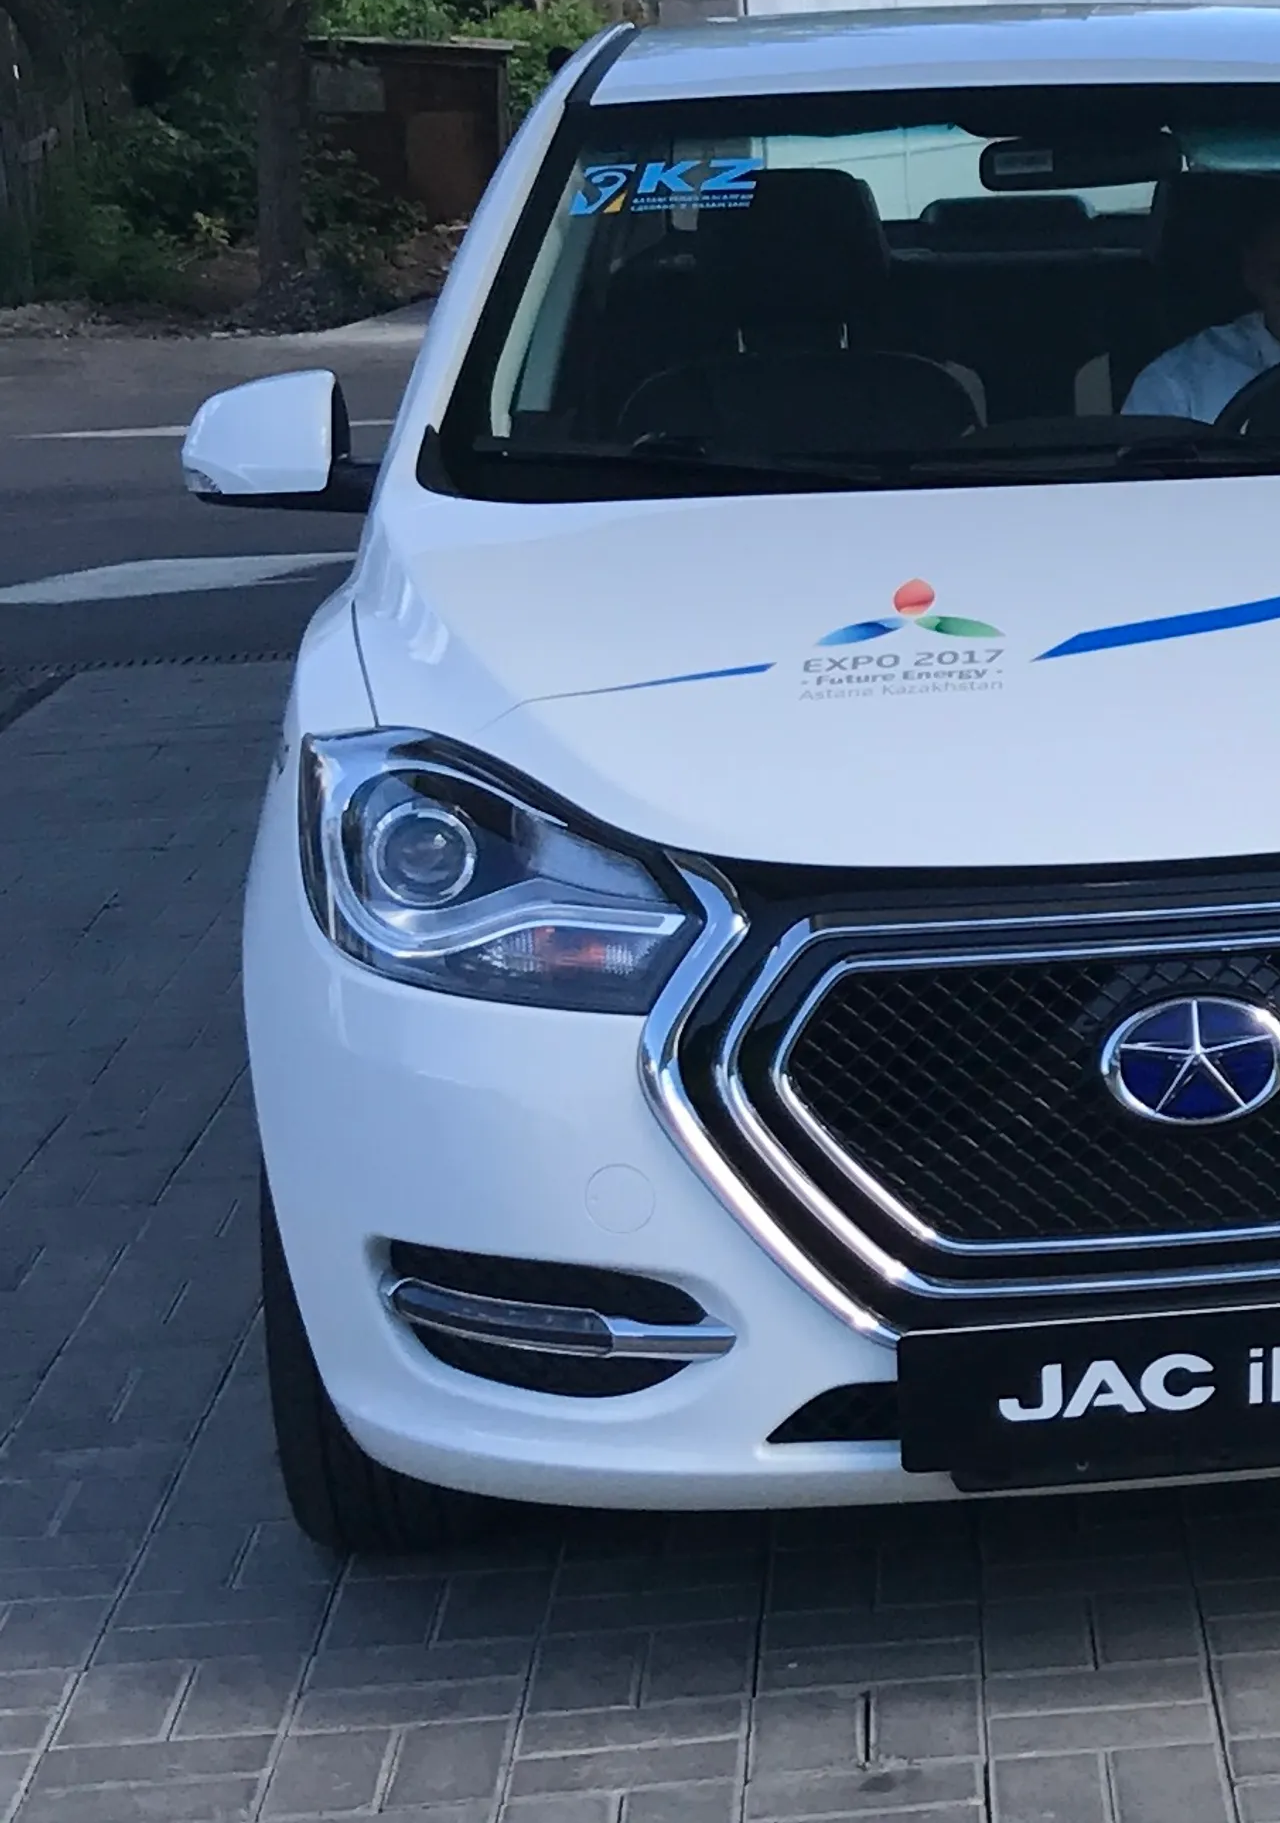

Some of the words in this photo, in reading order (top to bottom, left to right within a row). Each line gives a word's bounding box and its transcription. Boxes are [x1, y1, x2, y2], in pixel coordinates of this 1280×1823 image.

[637, 157, 764, 194] KZ
[803, 653, 900, 673] EXPO
[913, 648, 1005, 667] 2017
[815, 673, 896, 686] Future
[902, 667, 988, 681] Energy
[882, 681, 1003, 696] Kazakhstan
[998, 1353, 1215, 1422] JAC
